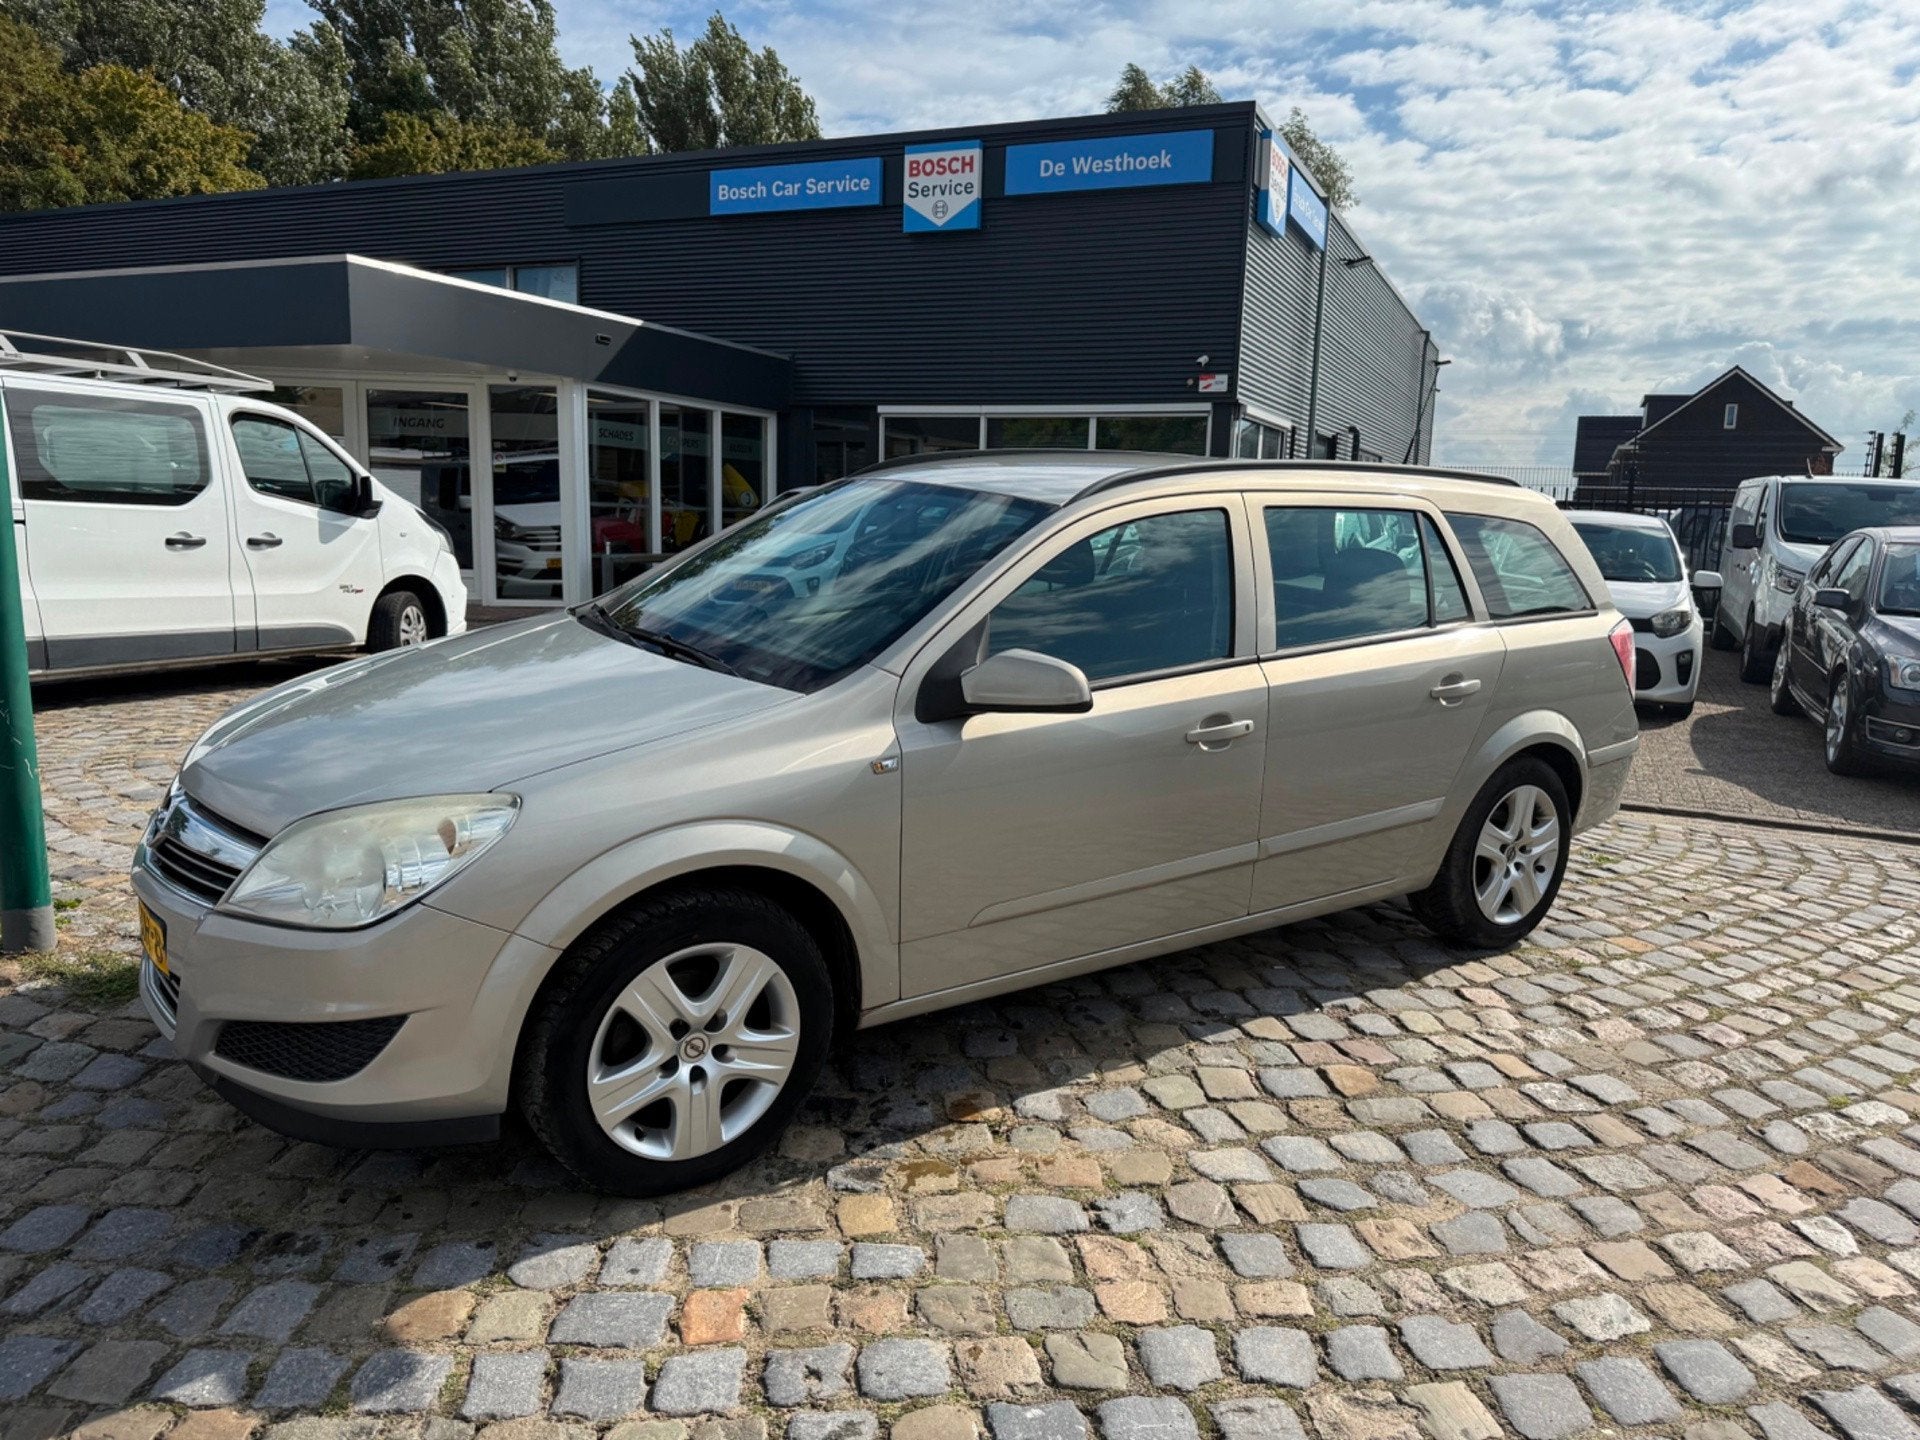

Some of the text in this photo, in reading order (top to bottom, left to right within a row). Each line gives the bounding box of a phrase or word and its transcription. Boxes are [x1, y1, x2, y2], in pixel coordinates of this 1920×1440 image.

[908, 154, 975, 178] BOSCH
[1039, 150, 1172, 178] De Westhoek
[718, 174, 871, 201] Bosch Car Service
[907, 179, 975, 199] Service
[393, 416, 445, 429] INGANG
[598, 428, 635, 442] SCHADES
